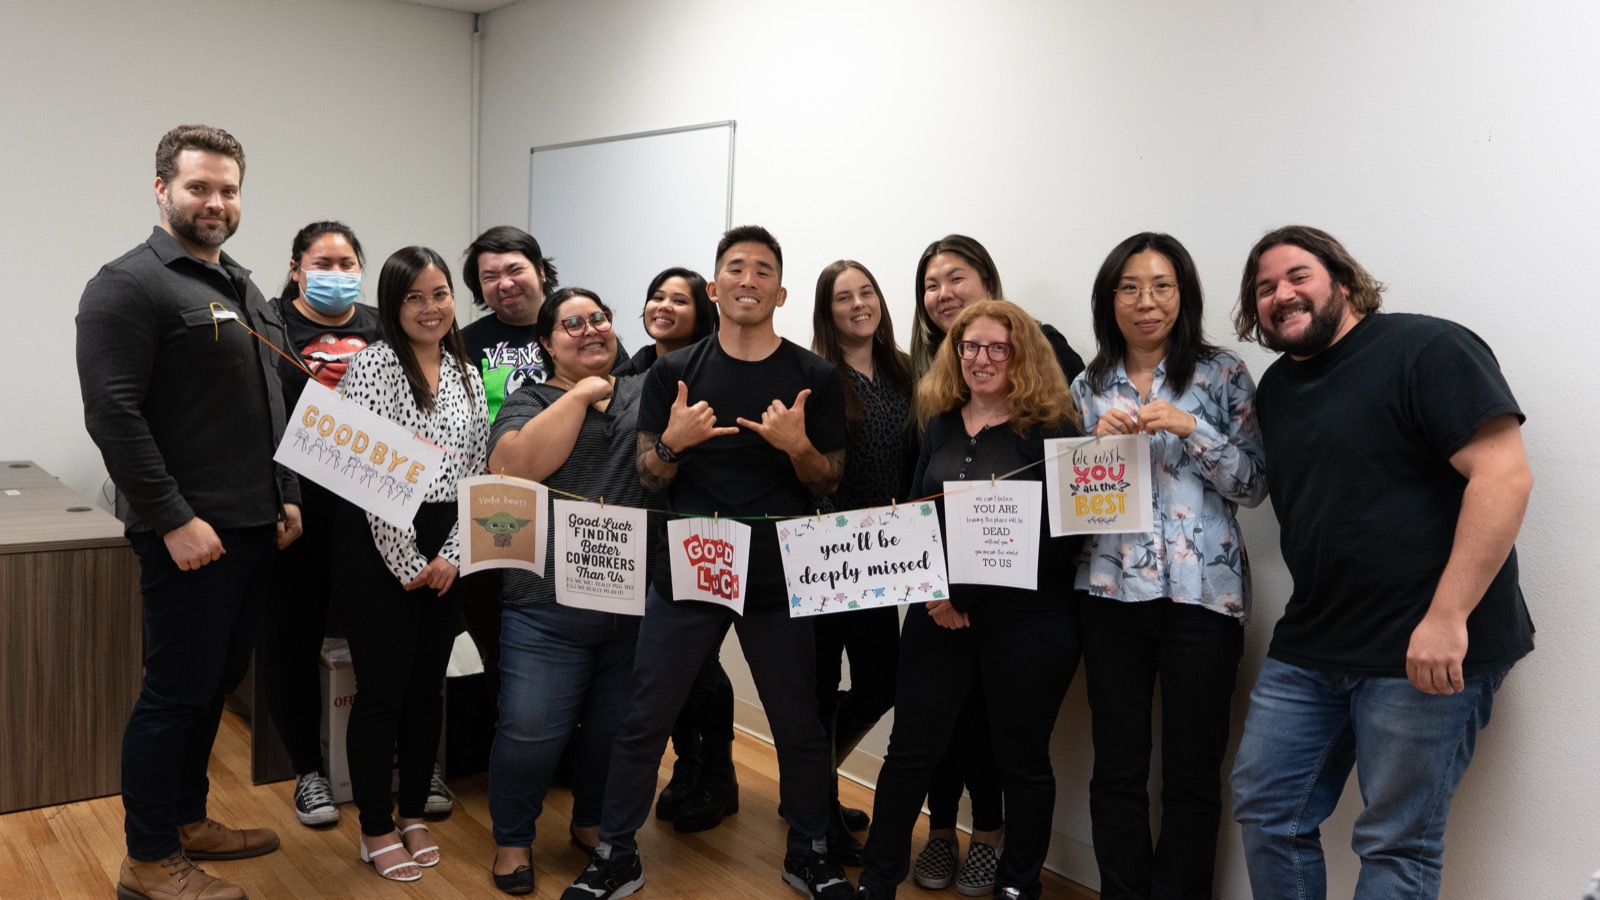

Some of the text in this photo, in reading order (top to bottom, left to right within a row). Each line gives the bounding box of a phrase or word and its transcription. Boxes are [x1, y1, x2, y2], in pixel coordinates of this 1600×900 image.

[302, 405, 425, 484] GOODBYE
[1072, 449, 1088, 465] We
[1073, 464, 1125, 485] YOU
[1100, 482, 1117, 492] the
[973, 504, 1018, 514] YOU ARE
[568, 513, 633, 532] Good Luck
[574, 527, 628, 544] FINDING
[982, 527, 1011, 536] DEAD
[580, 539, 621, 556] Better
[820, 529, 901, 561] you'll be
[566, 551, 635, 571] COWORKERS
[982, 558, 1012, 568] TO US
[576, 566, 625, 583] Than Us
[799, 550, 931, 590] deeply missed
[700, 570, 738, 595] LUCK
